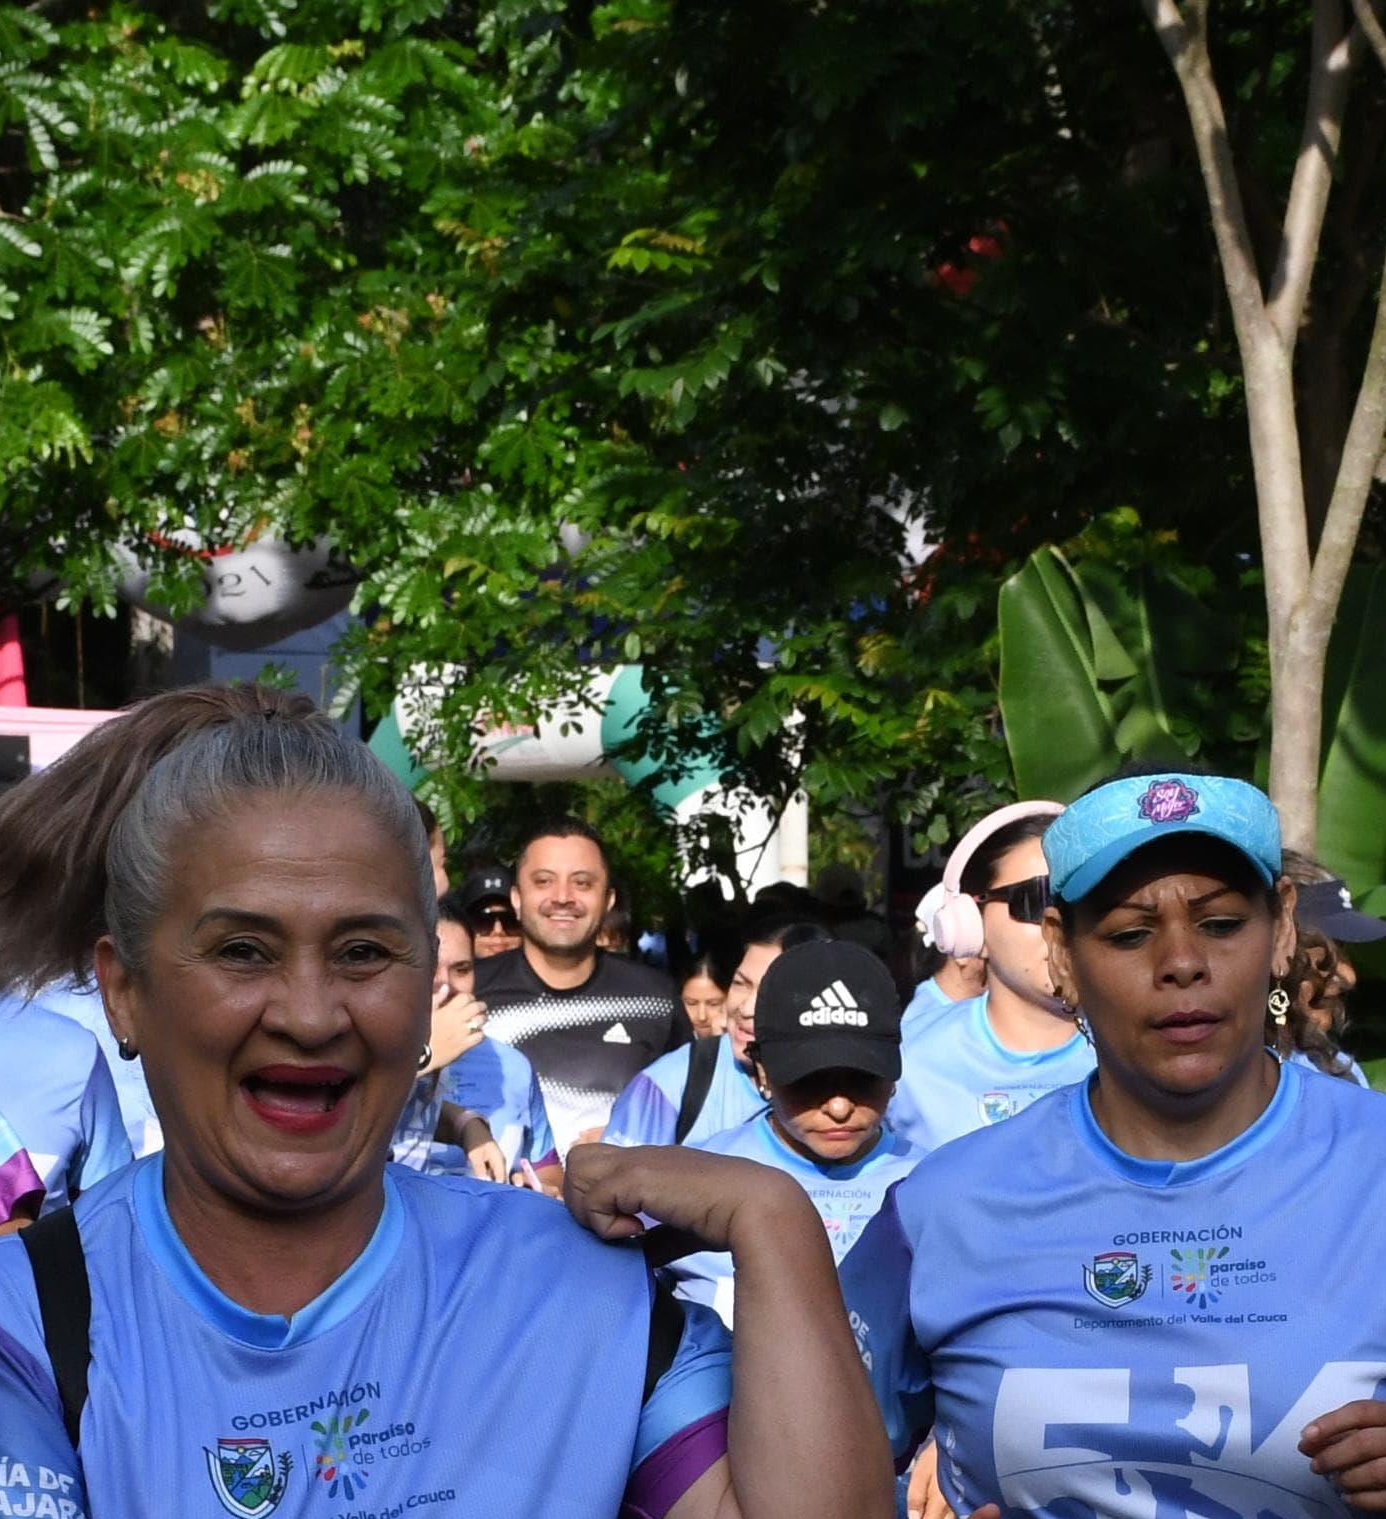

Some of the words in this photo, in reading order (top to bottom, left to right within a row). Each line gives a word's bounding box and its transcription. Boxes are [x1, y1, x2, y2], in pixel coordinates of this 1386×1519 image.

[799, 1006, 869, 1026] adidas
[1113, 1225, 1243, 1247] GOBERNACIÓN
[1210, 1258, 1266, 1276] paraíso
[1210, 1274, 1229, 1288] de
[1234, 1270, 1277, 1285] todos
[1073, 1316, 1163, 1331] Departamento
[1166, 1313, 1186, 1325] del
[1190, 1313, 1222, 1325] Valle
[1225, 1312, 1245, 1324] del
[1247, 1312, 1289, 1324] Cauca
[348, 1421, 416, 1450] paraíso
[352, 1448, 375, 1466] de
[380, 1435, 432, 1459] todos
[39, 1466, 75, 1495] DE
[406, 1488, 456, 1509] Cauca
